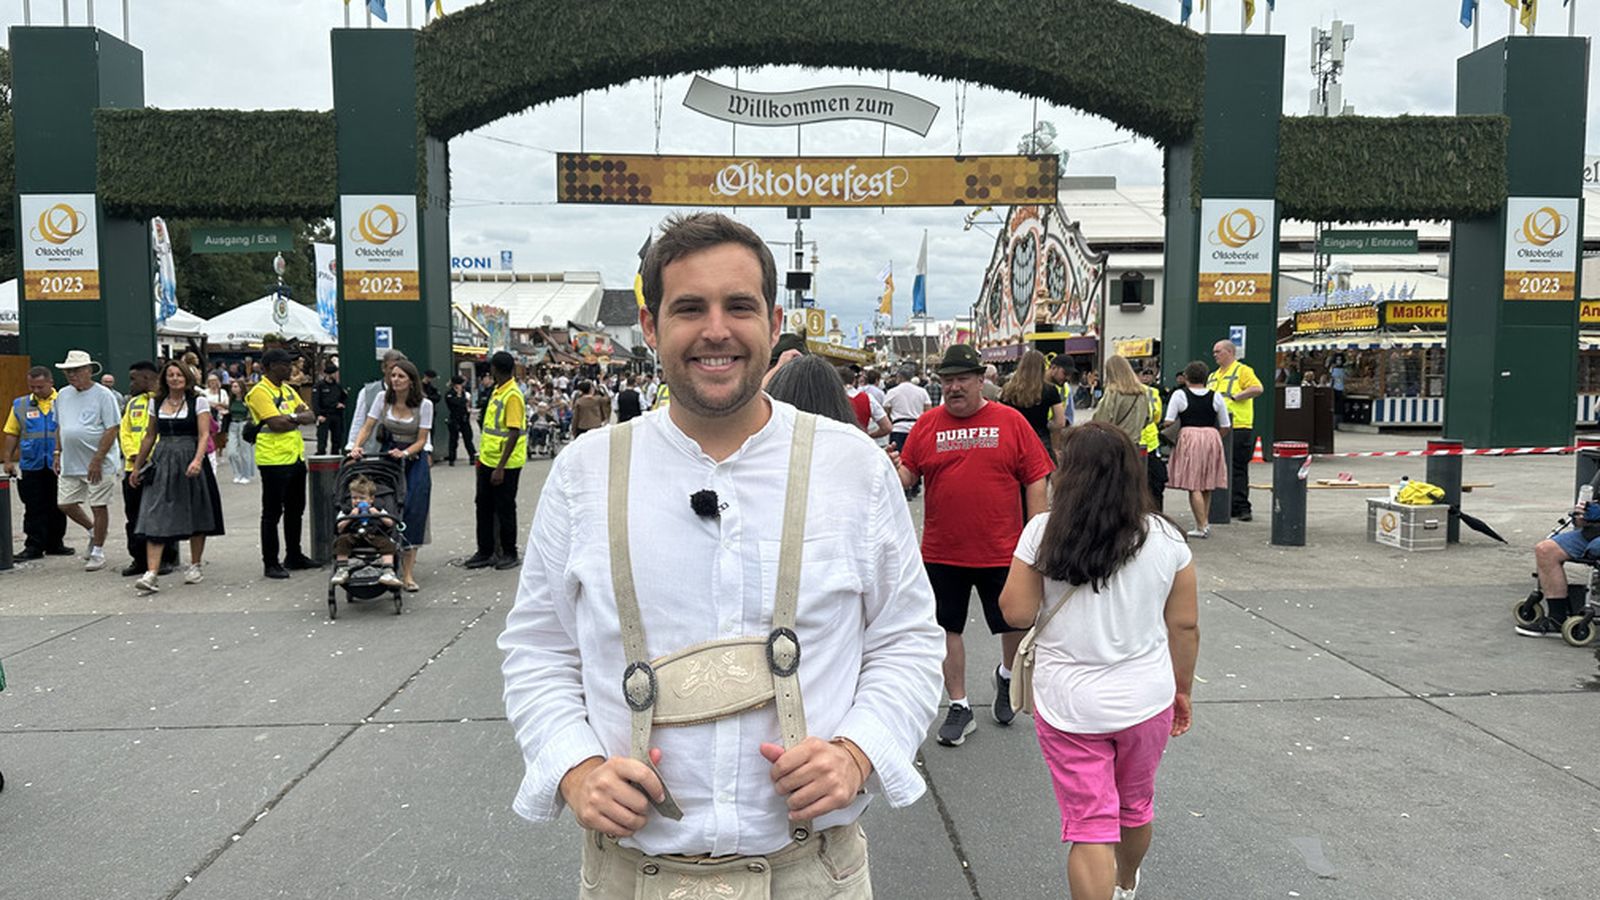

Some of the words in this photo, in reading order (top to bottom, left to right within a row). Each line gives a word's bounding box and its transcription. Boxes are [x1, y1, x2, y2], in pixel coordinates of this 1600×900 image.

[728, 95, 849, 119] Willkommen
[855, 97, 894, 116] zum
[709, 161, 909, 202] Oktoberfest
[204, 235, 250, 247] Ausgang
[257, 234, 278, 244] Exit
[1323, 237, 1364, 249] Eingang
[1370, 237, 1414, 247] Entrance
[35, 246, 84, 257] Oktoberfest
[355, 247, 404, 258] Oktoberfest
[1211, 250, 1259, 261] Oktoberfest
[1517, 248, 1564, 259] Oktoberfest
[452, 257, 491, 269] RONI
[40, 277, 84, 293] 2023
[359, 277, 403, 294] 2023
[1213, 279, 1256, 296] 2023
[1519, 277, 1560, 294] 2023
[936, 427, 999, 442] DURFEE
